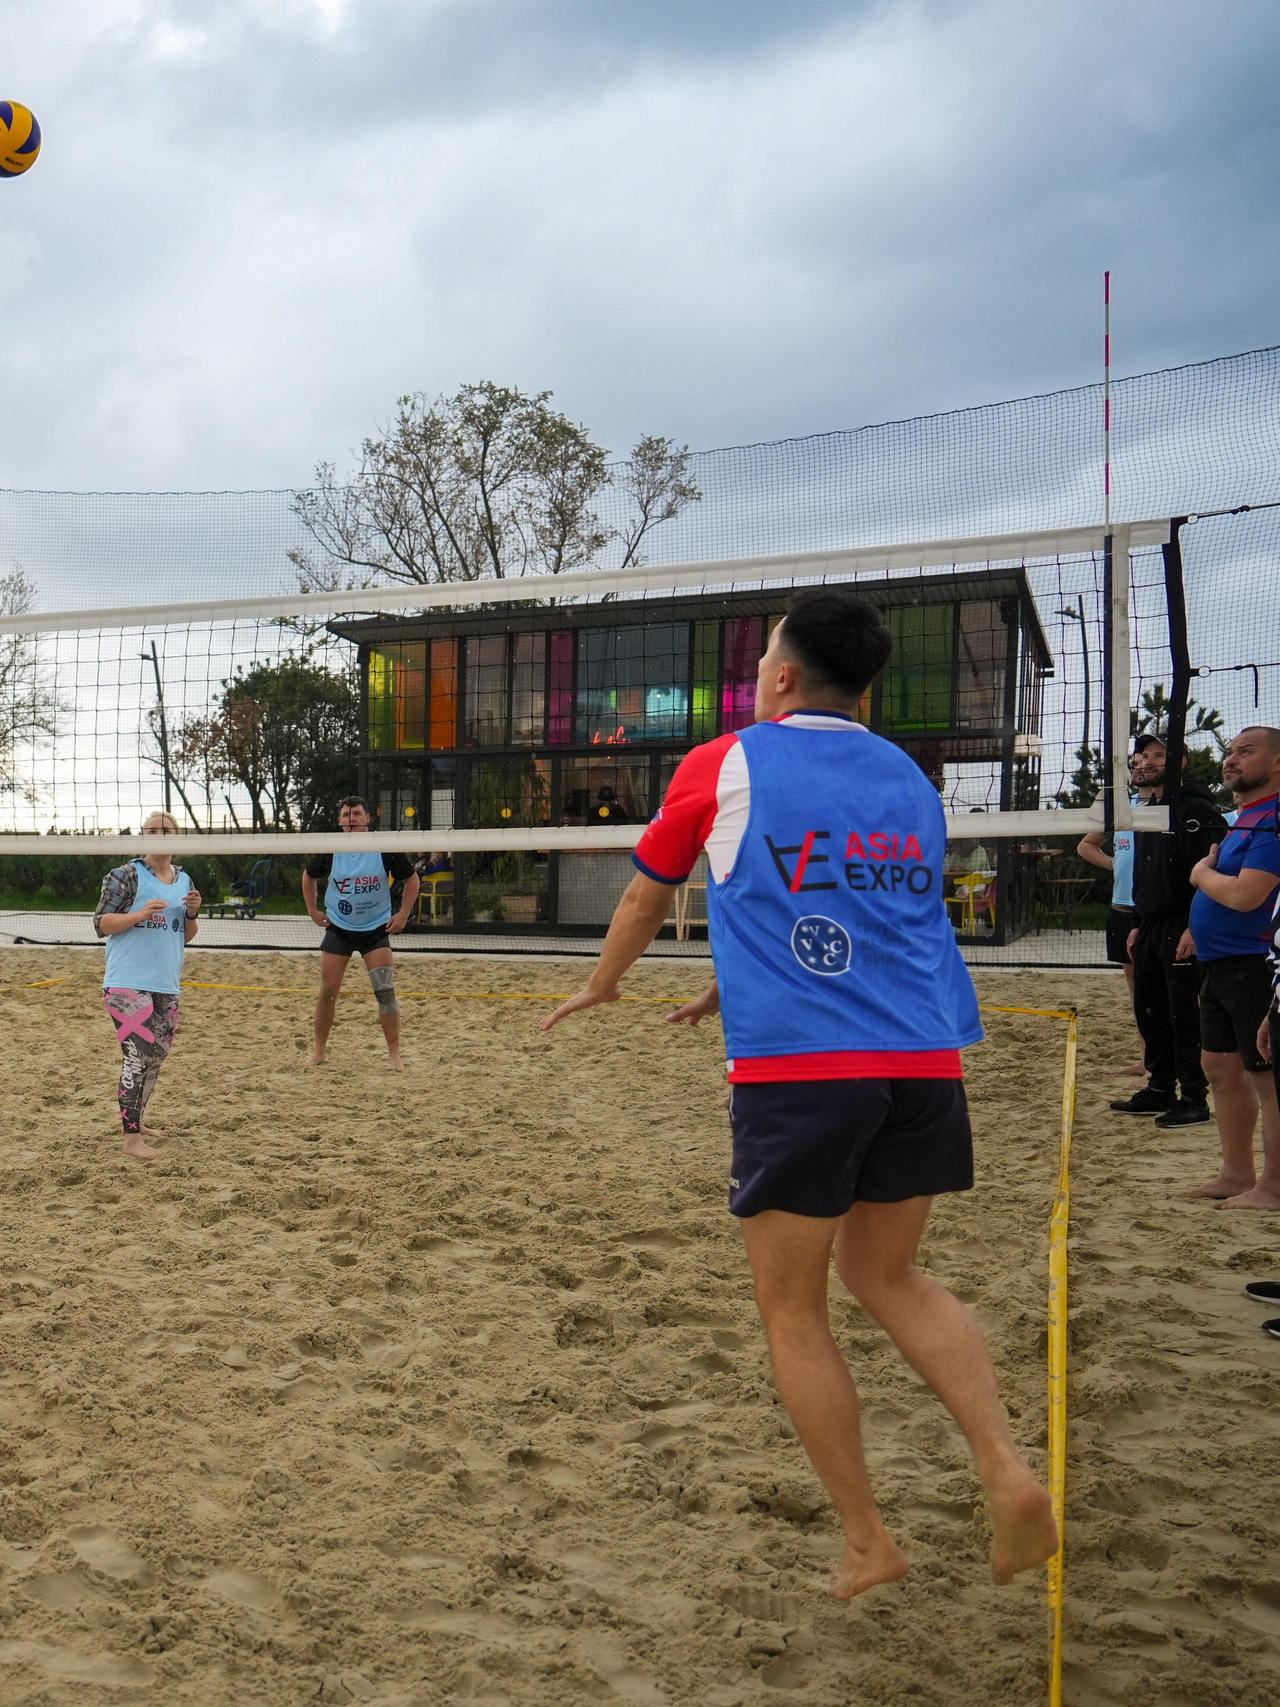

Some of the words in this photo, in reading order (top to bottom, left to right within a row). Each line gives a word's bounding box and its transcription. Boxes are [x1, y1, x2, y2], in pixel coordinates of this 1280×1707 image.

[845, 831, 924, 862] ASIA
[354, 875, 379, 886] ASIA
[844, 863, 933, 895] EXPO
[354, 883, 381, 894] EXPO
[147, 914, 167, 923] ASIA
[146, 921, 168, 931] EXPO
